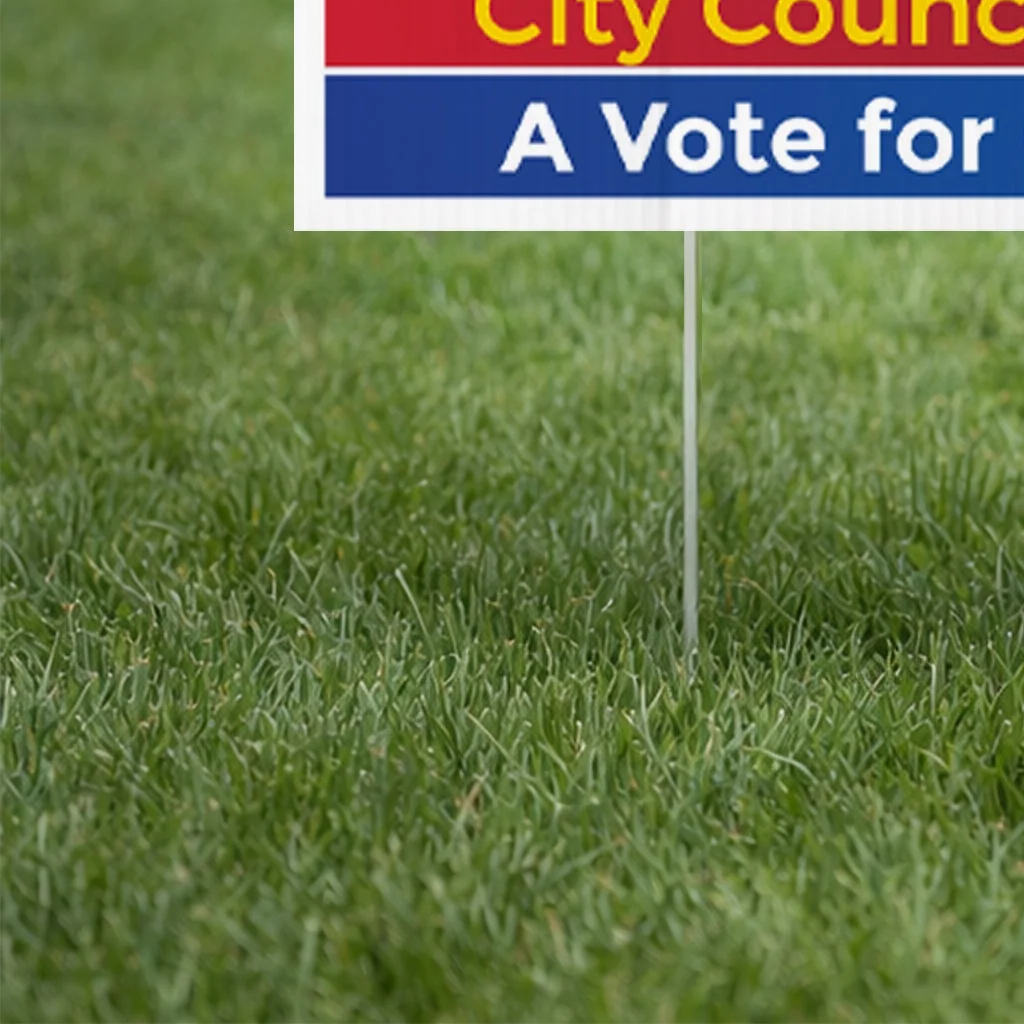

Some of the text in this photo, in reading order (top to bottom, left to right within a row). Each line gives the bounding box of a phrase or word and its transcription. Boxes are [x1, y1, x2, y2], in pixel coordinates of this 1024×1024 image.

[500, 103, 574, 172] A
[602, 103, 825, 173] Vote
[858, 97, 994, 173] for
